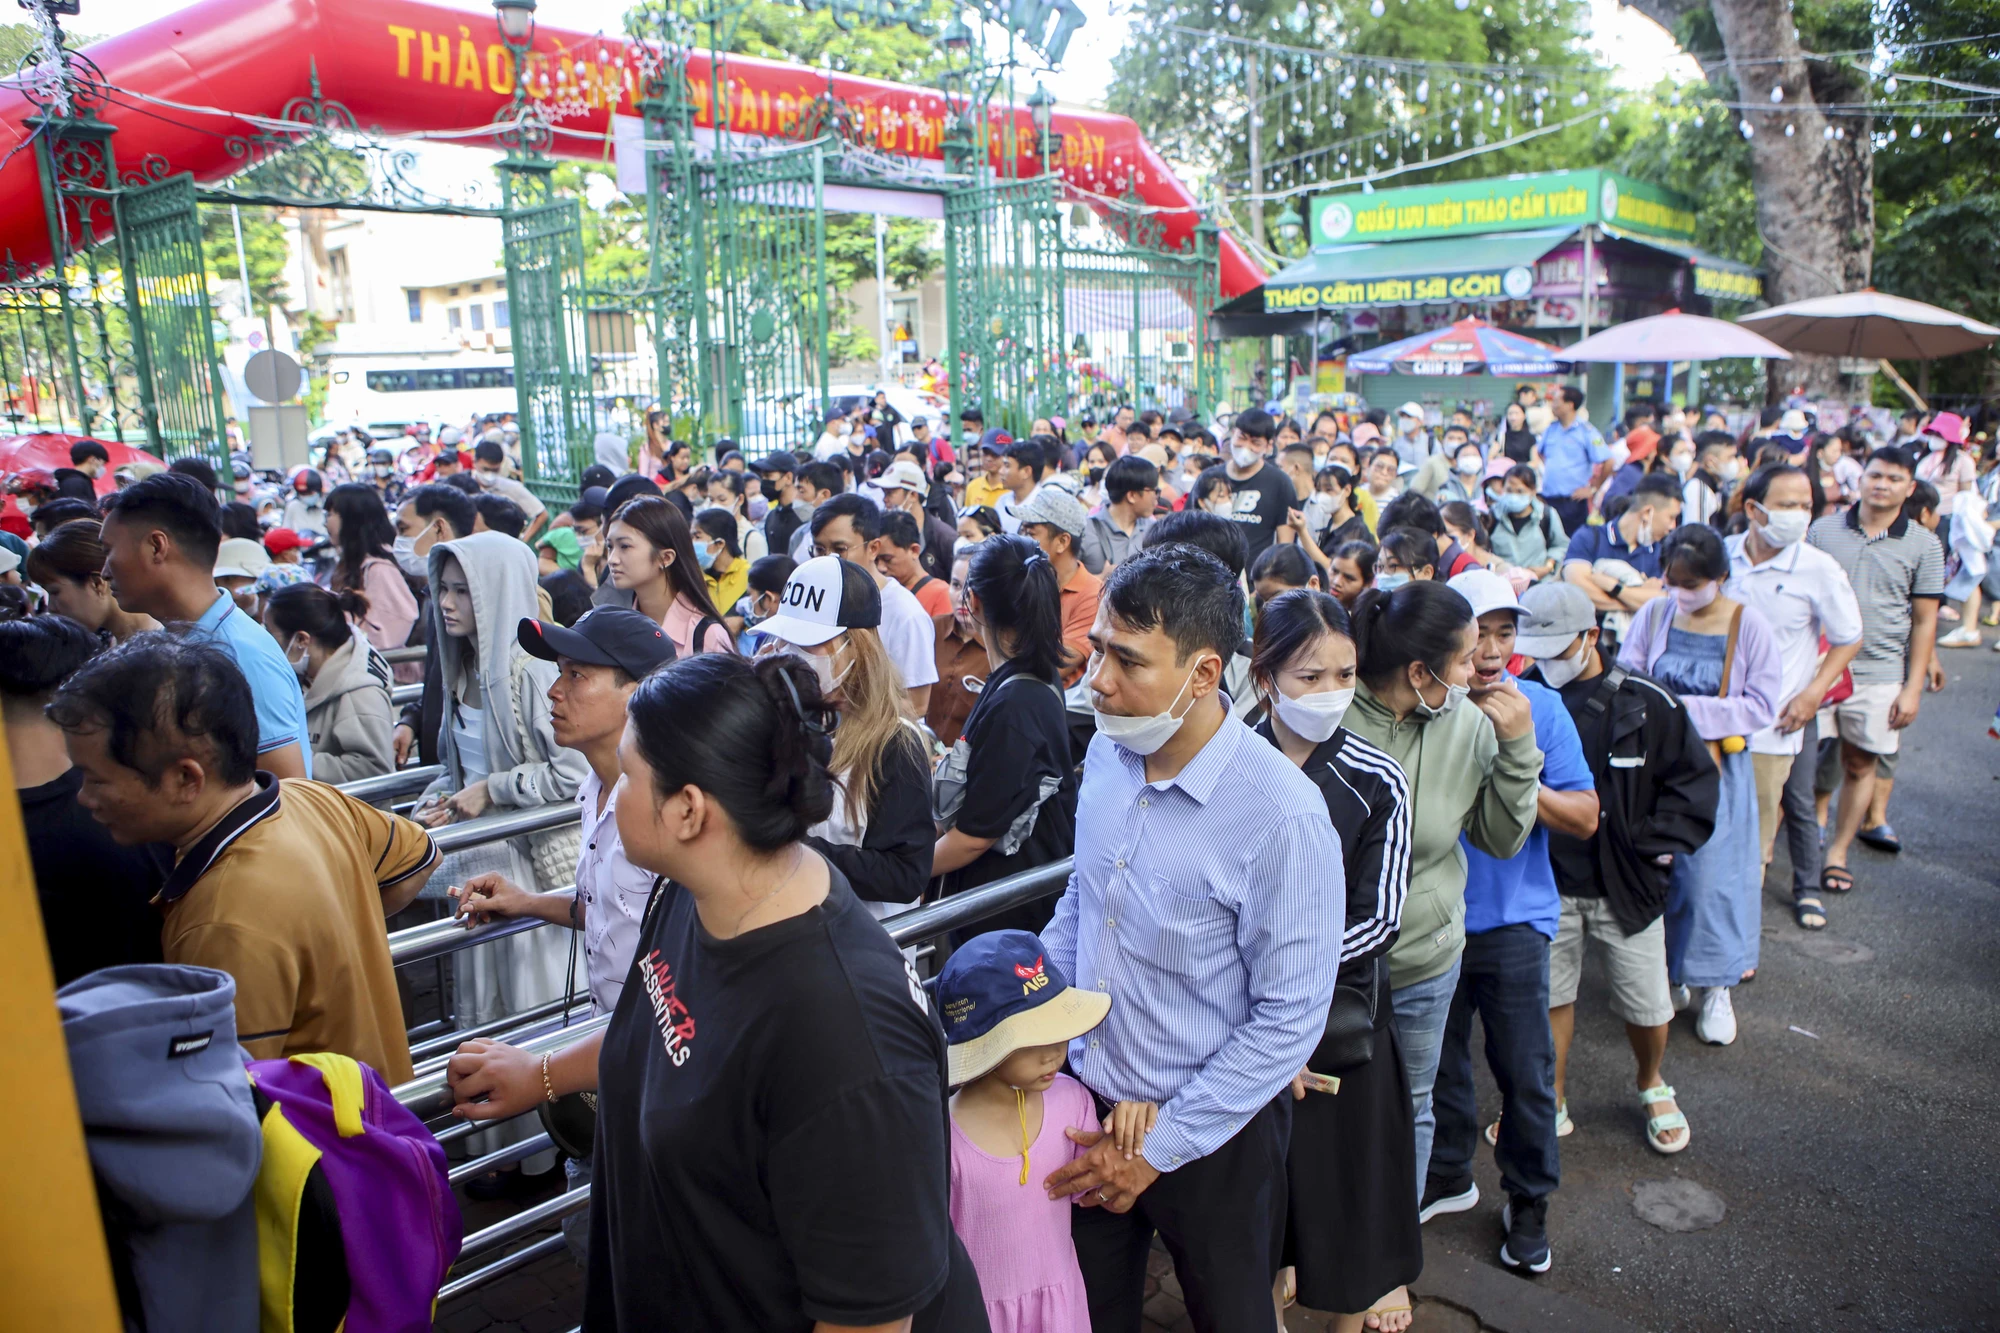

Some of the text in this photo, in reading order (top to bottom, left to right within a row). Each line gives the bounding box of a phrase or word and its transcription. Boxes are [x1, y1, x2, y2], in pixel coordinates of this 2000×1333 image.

[388, 24, 515, 95] THẢO
[638, 951, 691, 1067] ESSENTIALS
[580, 1091, 598, 1112] adida
